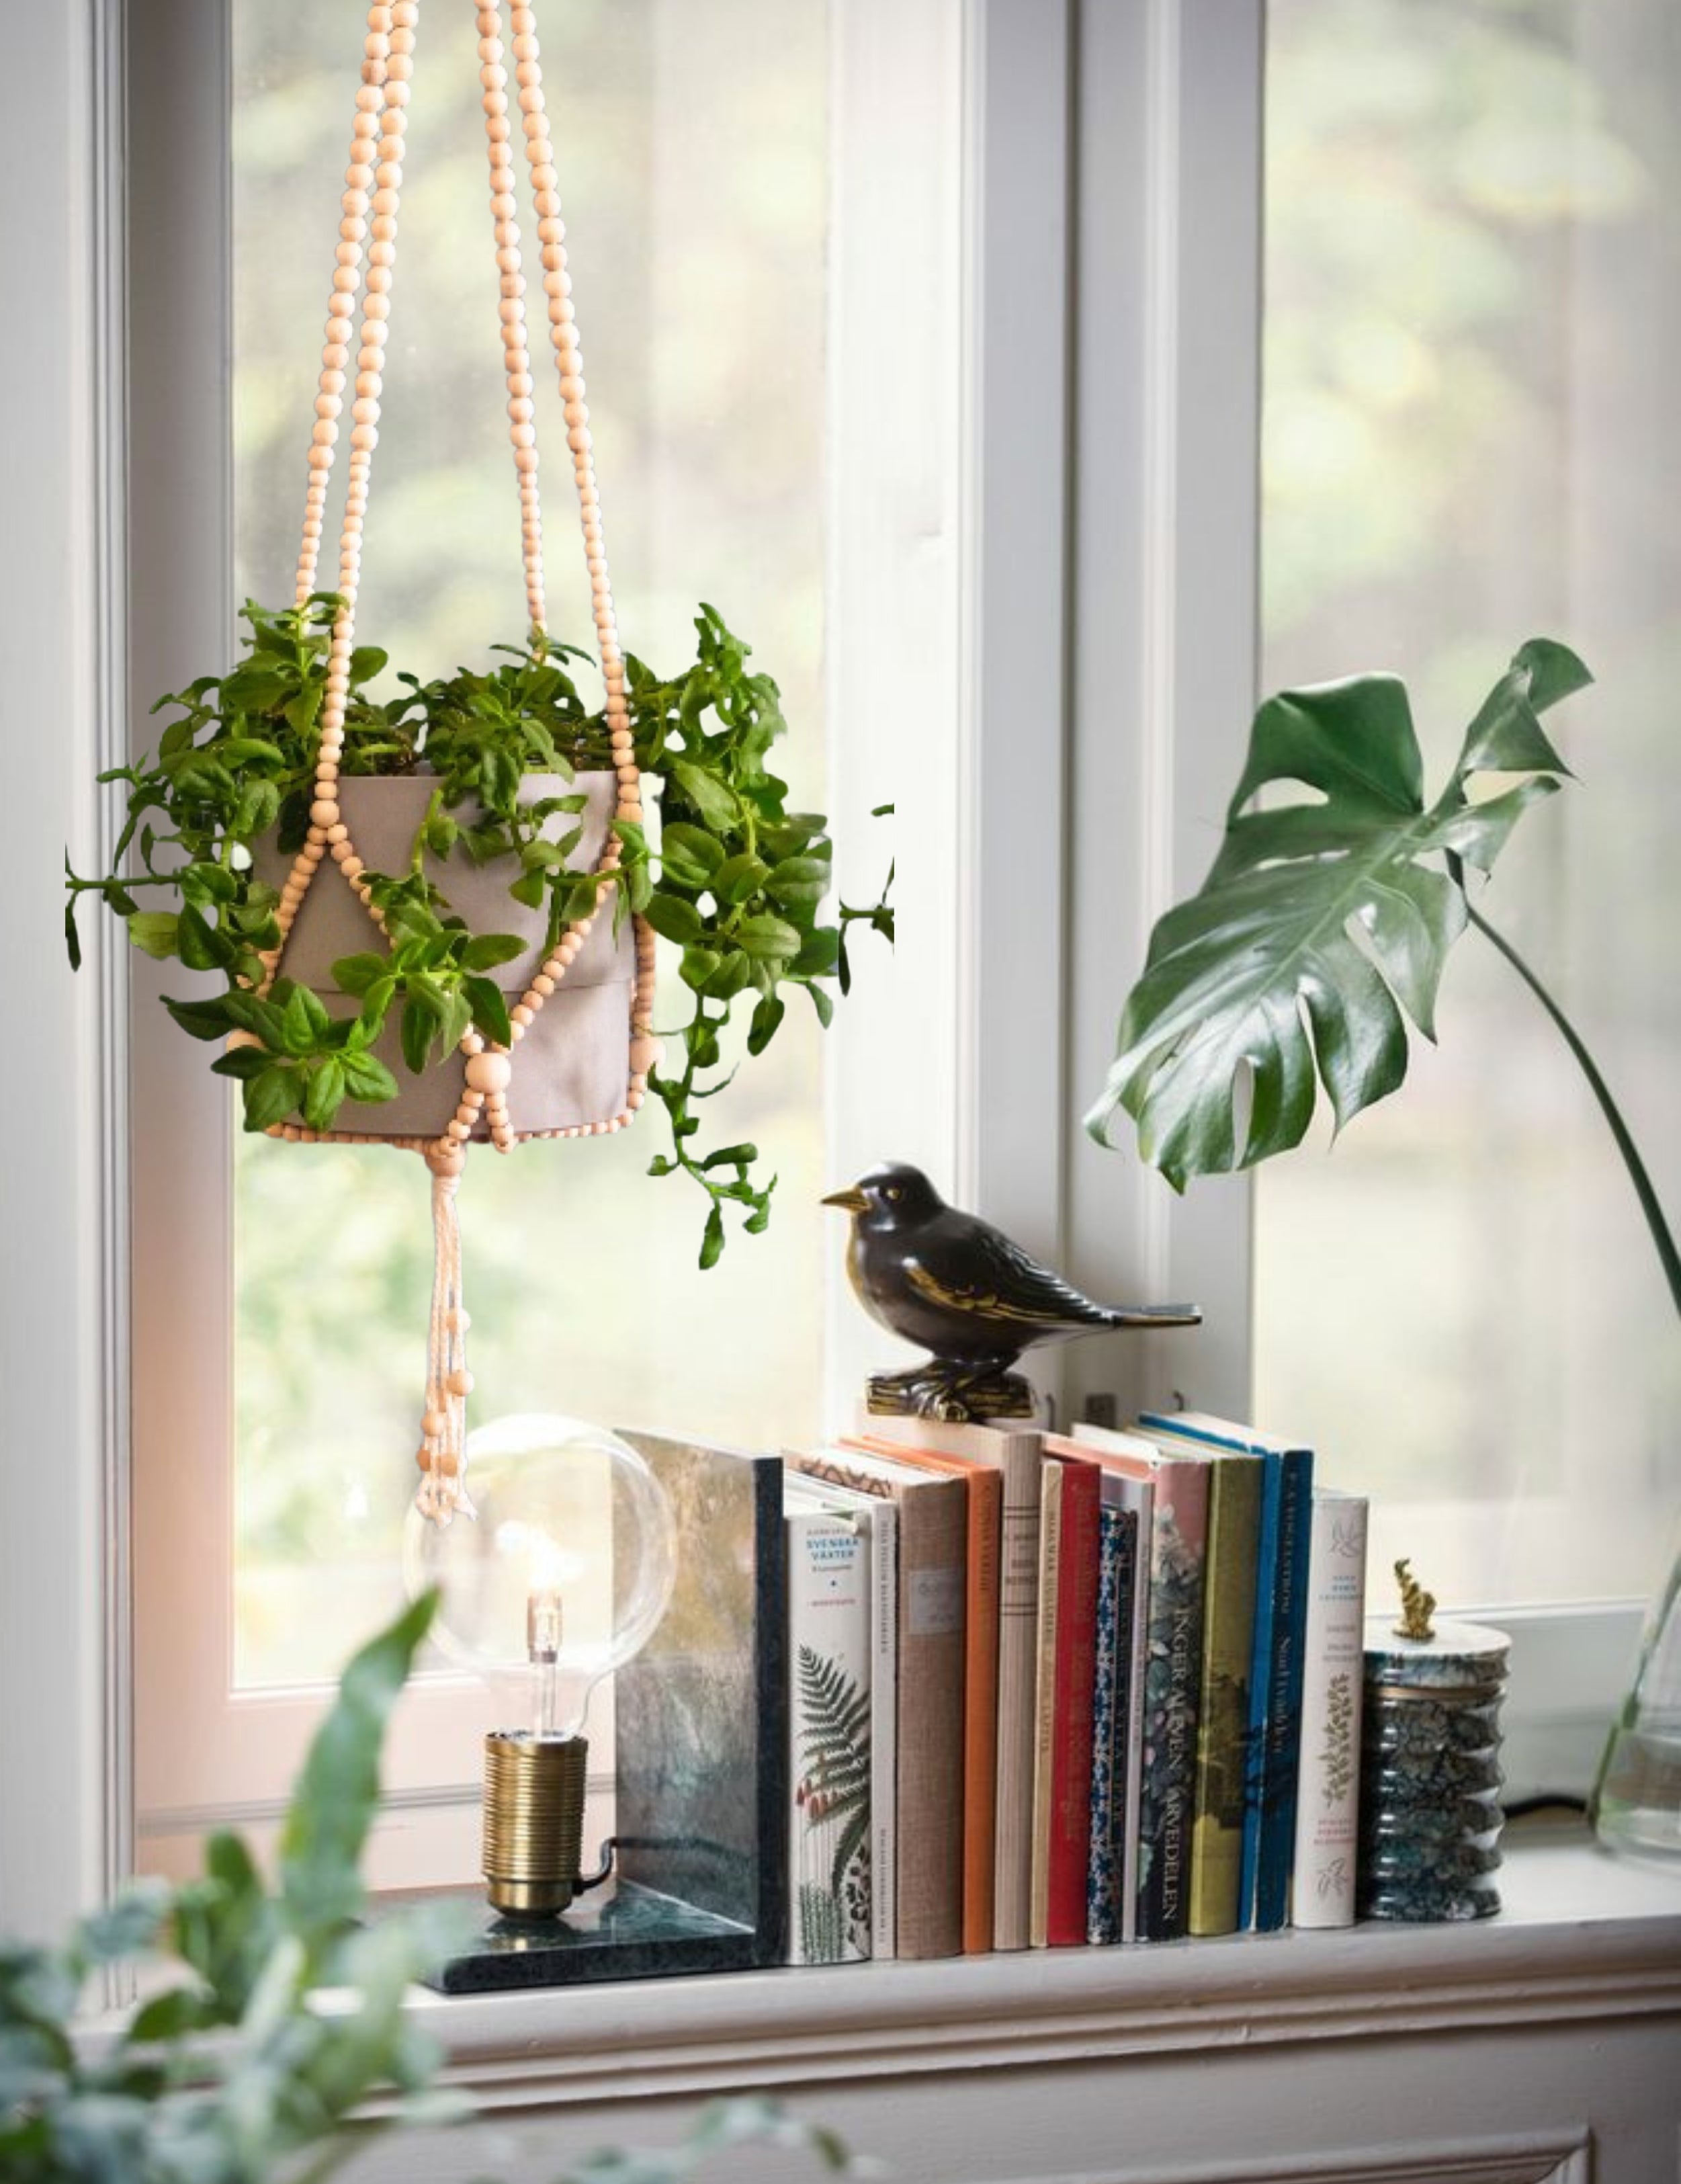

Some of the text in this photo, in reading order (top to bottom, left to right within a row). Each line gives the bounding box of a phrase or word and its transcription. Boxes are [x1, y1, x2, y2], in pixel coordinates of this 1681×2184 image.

[806, 1538, 858, 1548] SVENSKA
[1172, 1608, 1188, 1681] INGER
[1164, 1789, 1180, 1920] ARVEDELEN
